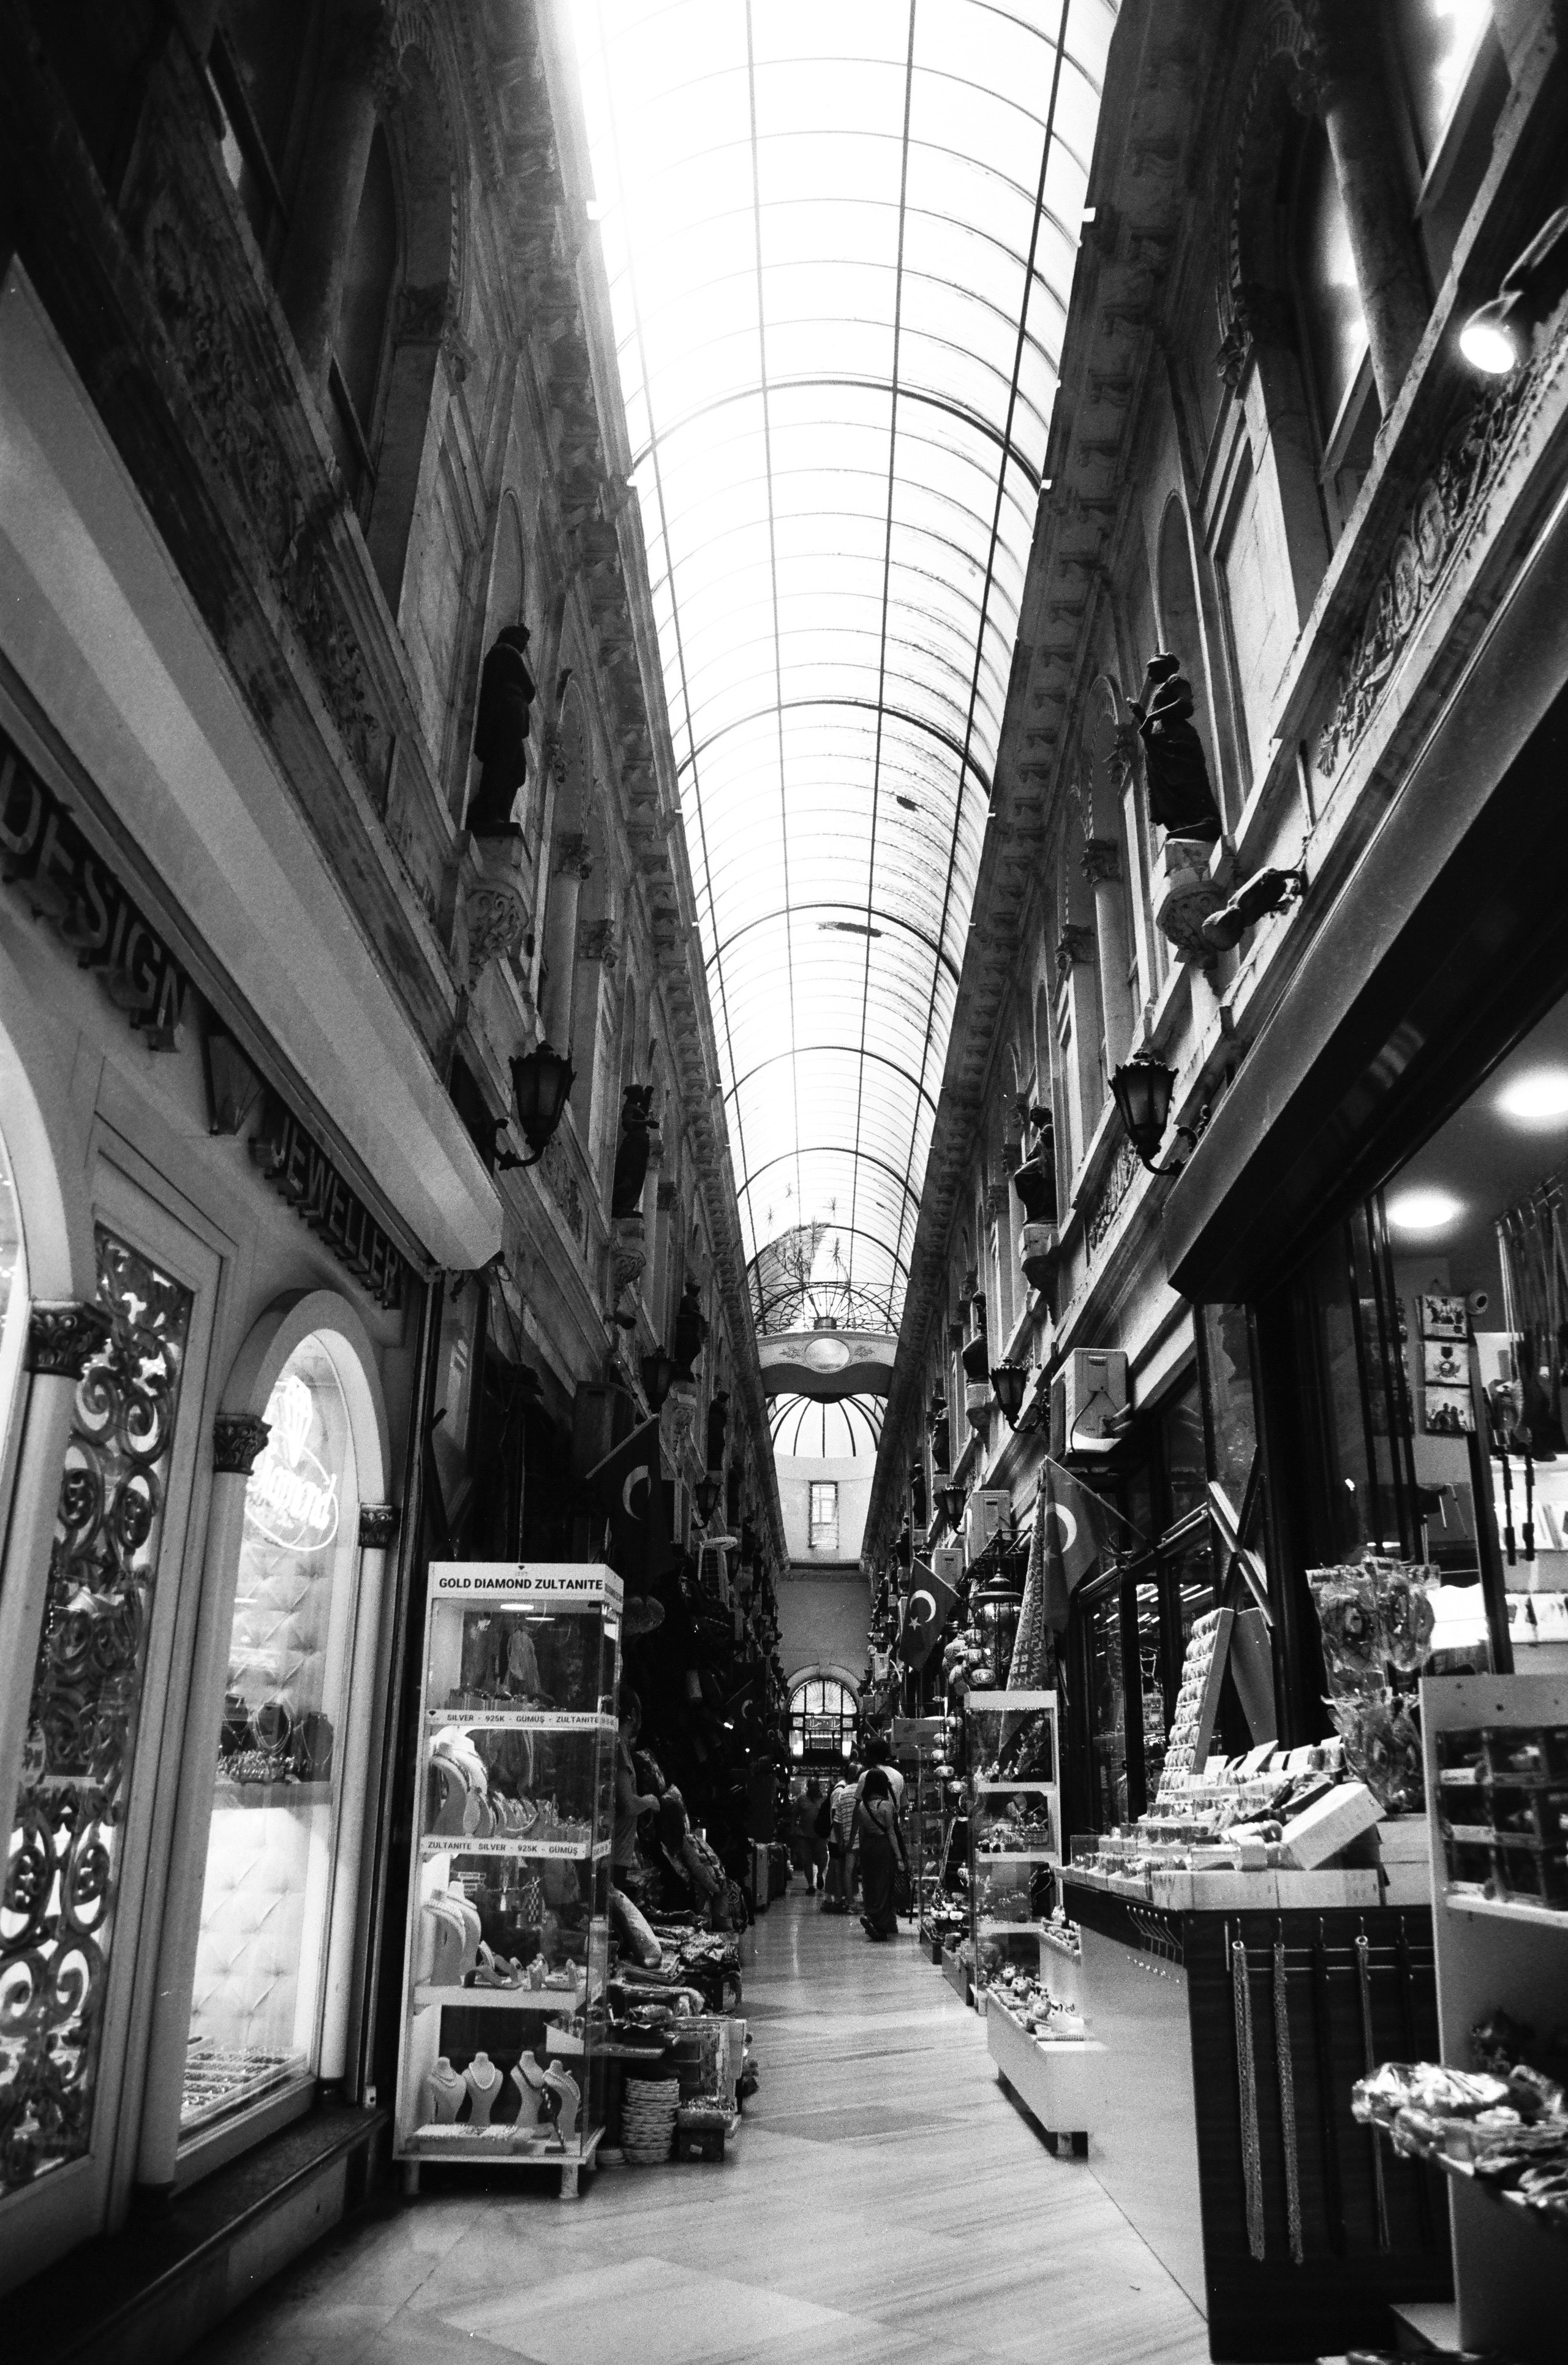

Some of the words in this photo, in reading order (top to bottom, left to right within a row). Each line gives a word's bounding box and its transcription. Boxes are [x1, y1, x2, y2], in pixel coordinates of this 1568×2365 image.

[0, 753, 190, 1050] DESIGN
[439, 1578, 471, 1588] GOLD
[474, 1578, 532, 1590] DIAMOND
[535, 1579, 603, 1590] ZULTANITE
[556, 1715, 599, 1724] ZULTANITE
[428, 1841, 472, 1850] ZULTANITE
[478, 1843, 506, 1851] SILVER
